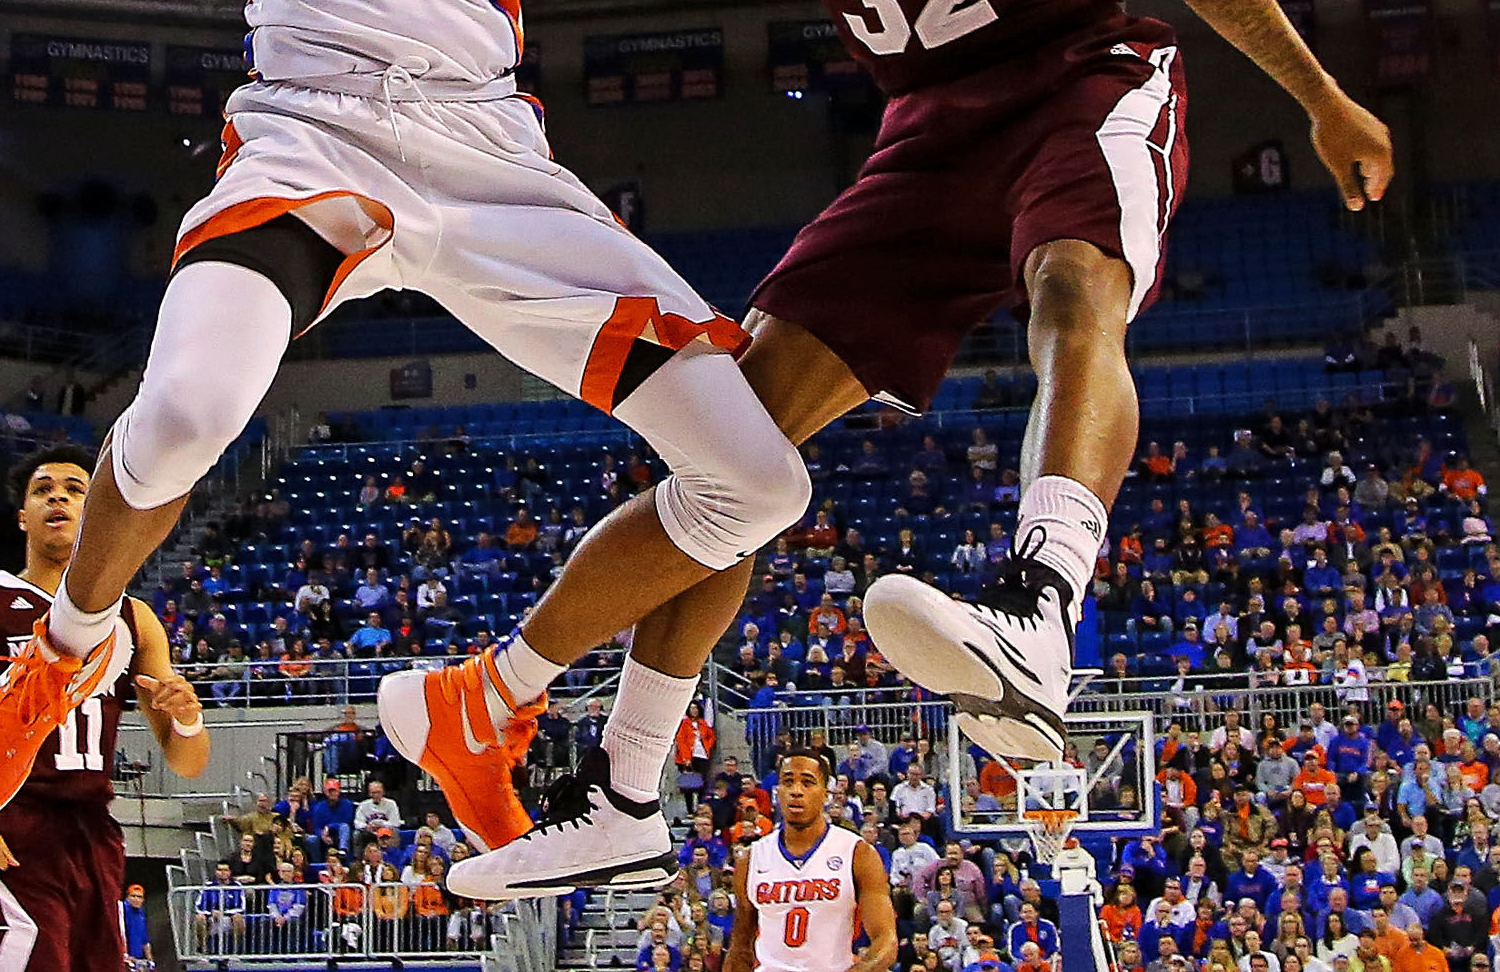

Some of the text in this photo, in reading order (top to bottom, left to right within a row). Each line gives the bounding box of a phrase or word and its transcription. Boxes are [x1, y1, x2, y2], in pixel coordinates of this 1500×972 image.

[47, 40, 150, 64] GYMNASTICS
[618, 30, 722, 54] GYMNASTICS
[54, 697, 104, 772] 11
[756, 877, 842, 904] GATORS
[784, 906, 810, 949] 0
